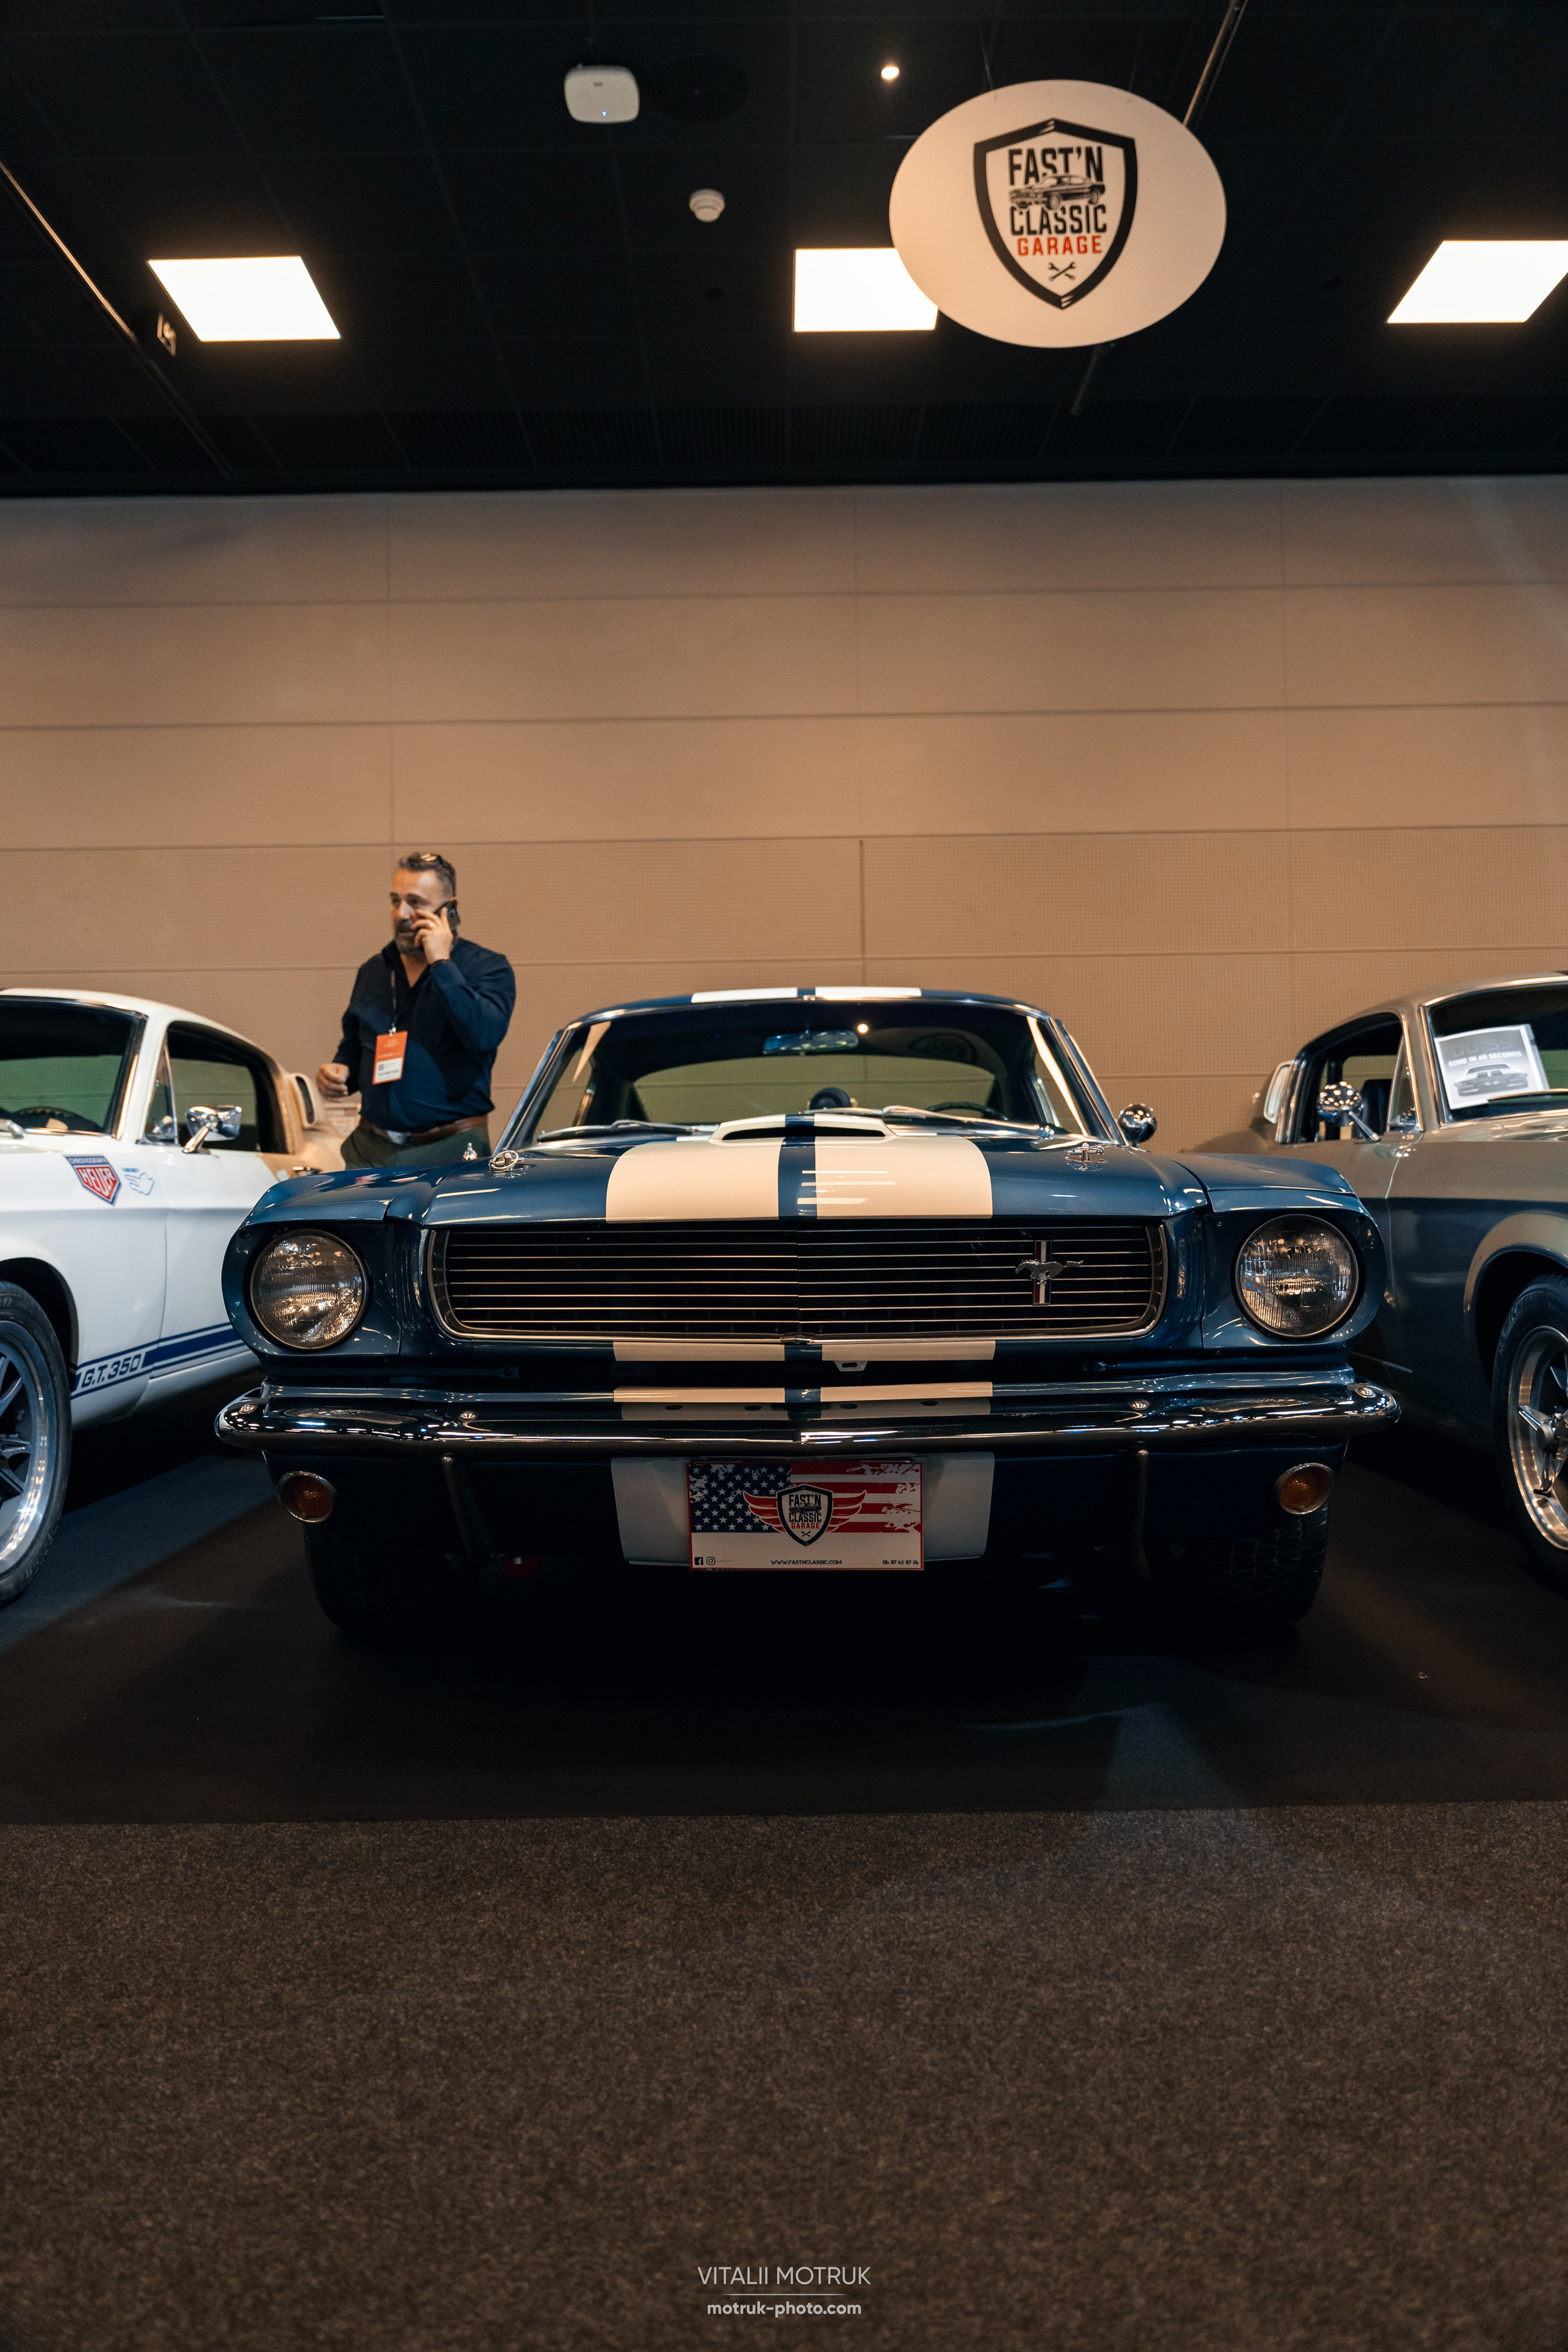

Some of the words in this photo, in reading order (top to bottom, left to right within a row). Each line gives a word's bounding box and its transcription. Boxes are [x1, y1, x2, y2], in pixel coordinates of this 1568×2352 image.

[1008, 146, 1103, 186] FAST'N
[1011, 204, 1107, 236] CLASSIC
[1017, 235, 1102, 256] GARAGE
[1448, 1057, 1467, 1067] GONE
[1488, 1050, 1522, 1060] SECONDS
[78, 1167, 116, 1197] HEUER
[789, 1494, 821, 1507] FAST'N
[789, 1513, 822, 1523] CLASSIC
